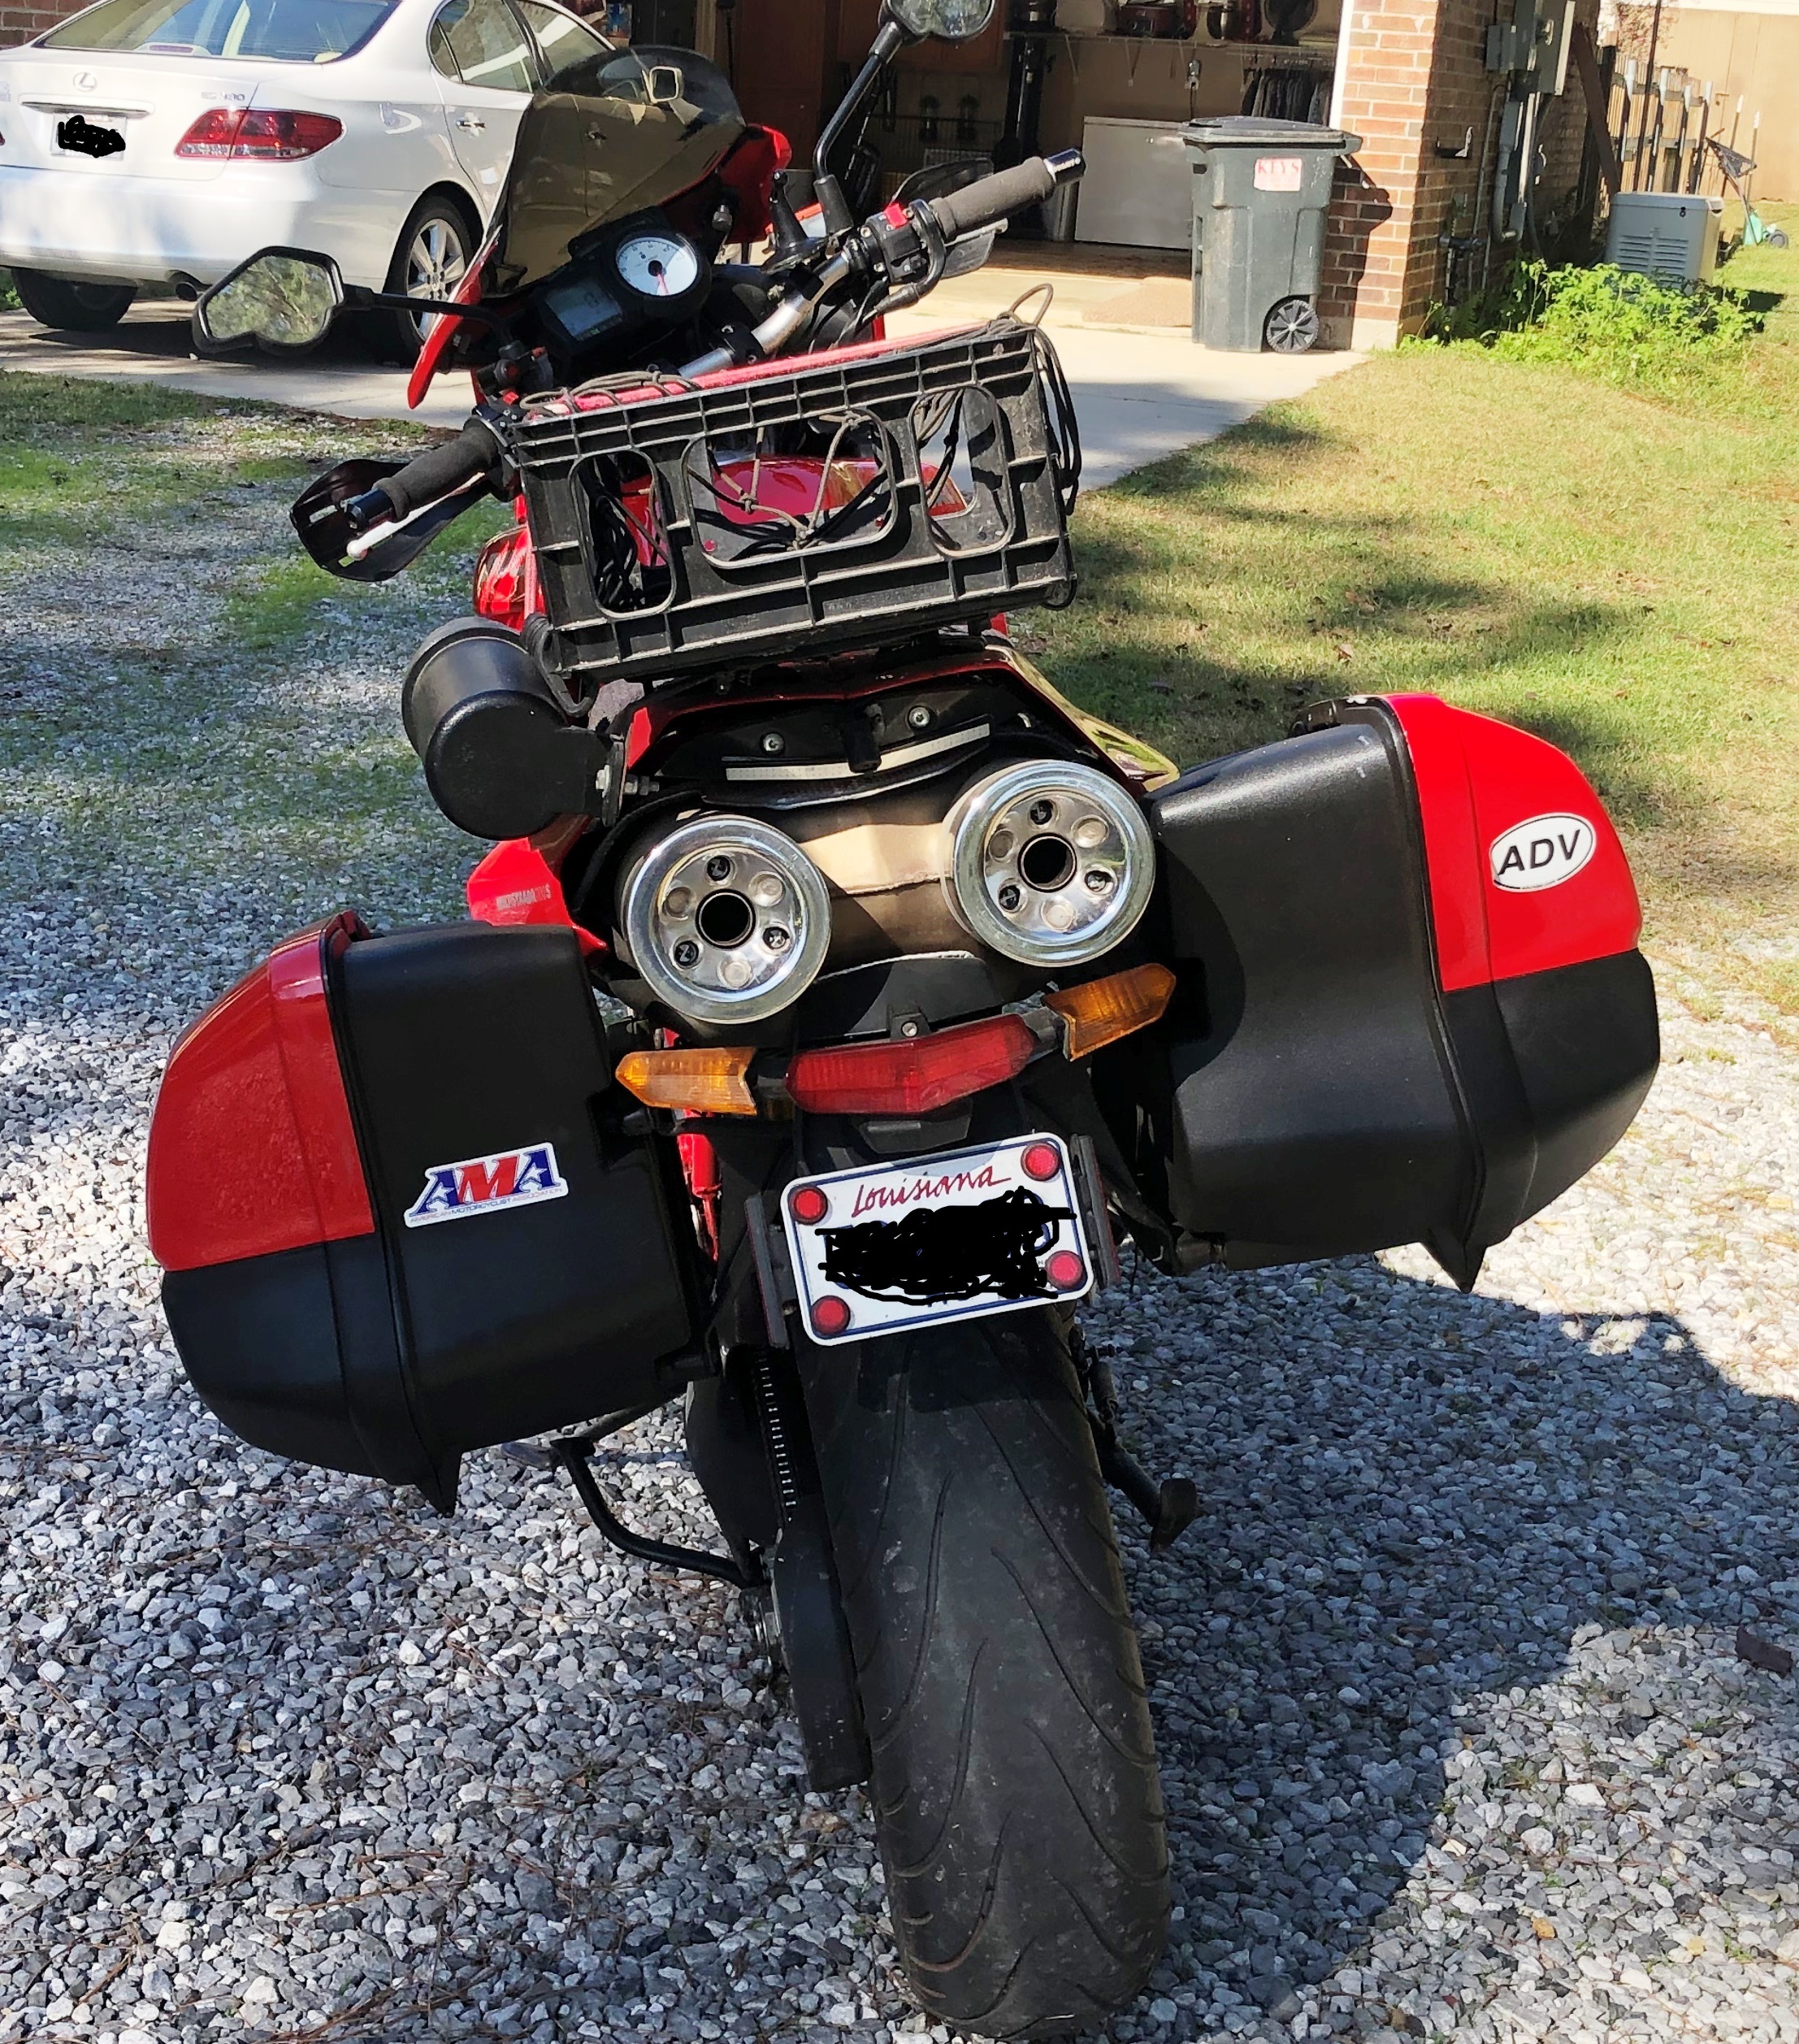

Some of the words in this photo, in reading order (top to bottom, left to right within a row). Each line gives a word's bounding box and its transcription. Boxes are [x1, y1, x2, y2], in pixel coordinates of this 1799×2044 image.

[1498, 829, 1580, 875] ADV
[409, 1148, 561, 1217] AMA
[451, 1198, 512, 1215] MOTORCYCLIST
[851, 1165, 1012, 1217] Louisiana
